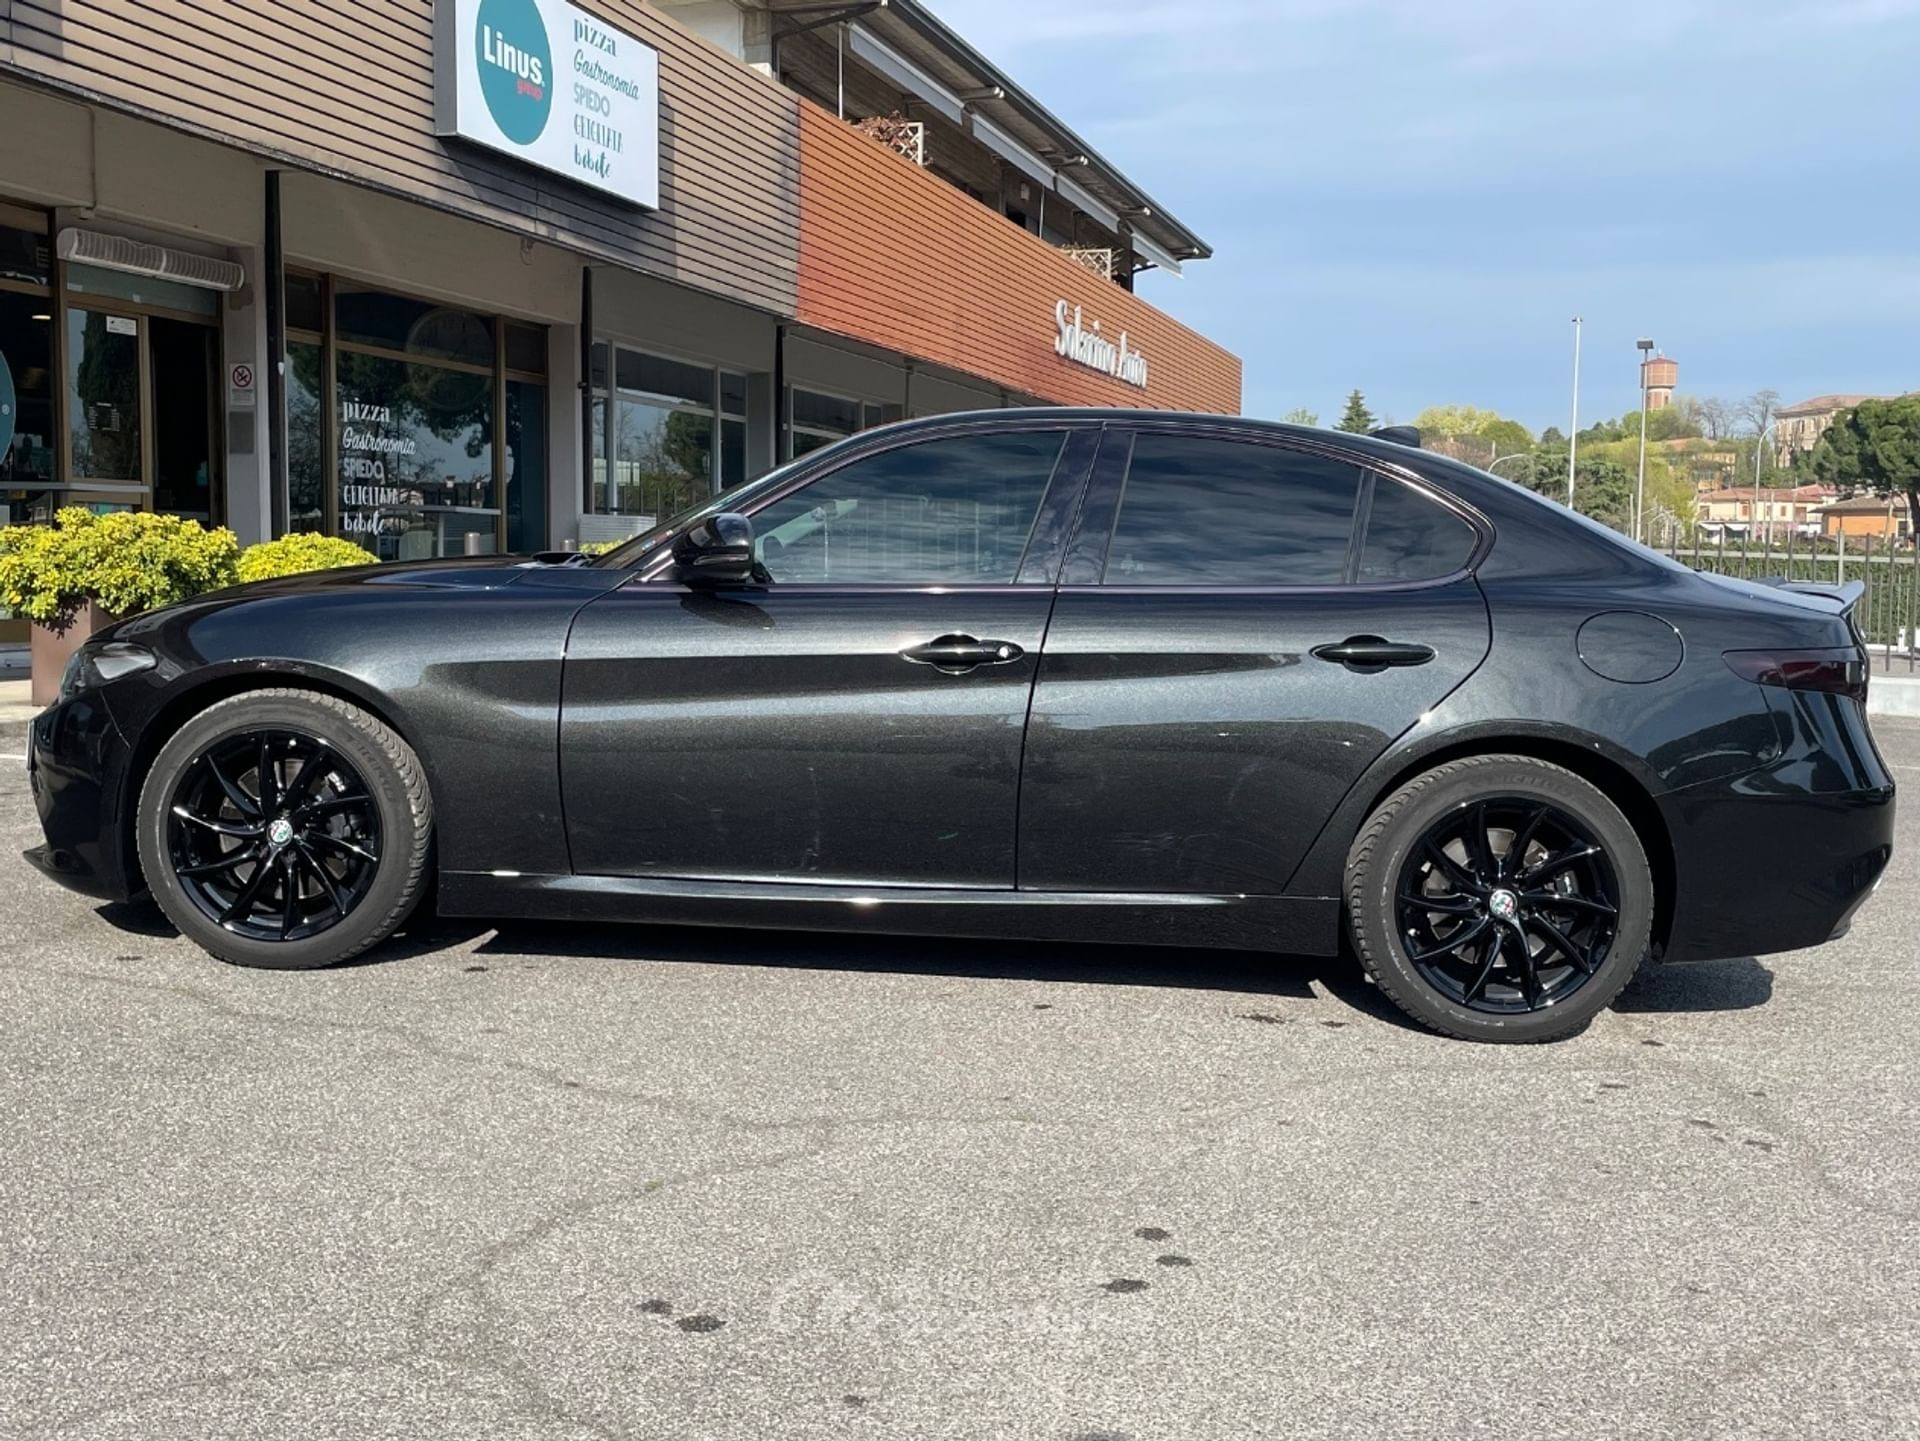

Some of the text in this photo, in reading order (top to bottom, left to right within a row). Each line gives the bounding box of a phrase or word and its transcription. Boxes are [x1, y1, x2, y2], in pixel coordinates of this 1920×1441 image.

[573, 18, 617, 57] pizza
[573, 49, 641, 100] Gastronomia
[573, 82, 611, 118] SPIEDO
[342, 397, 390, 423] pizza
[342, 426, 417, 455] Gastronomia
[343, 457, 385, 485] SPIEDO
